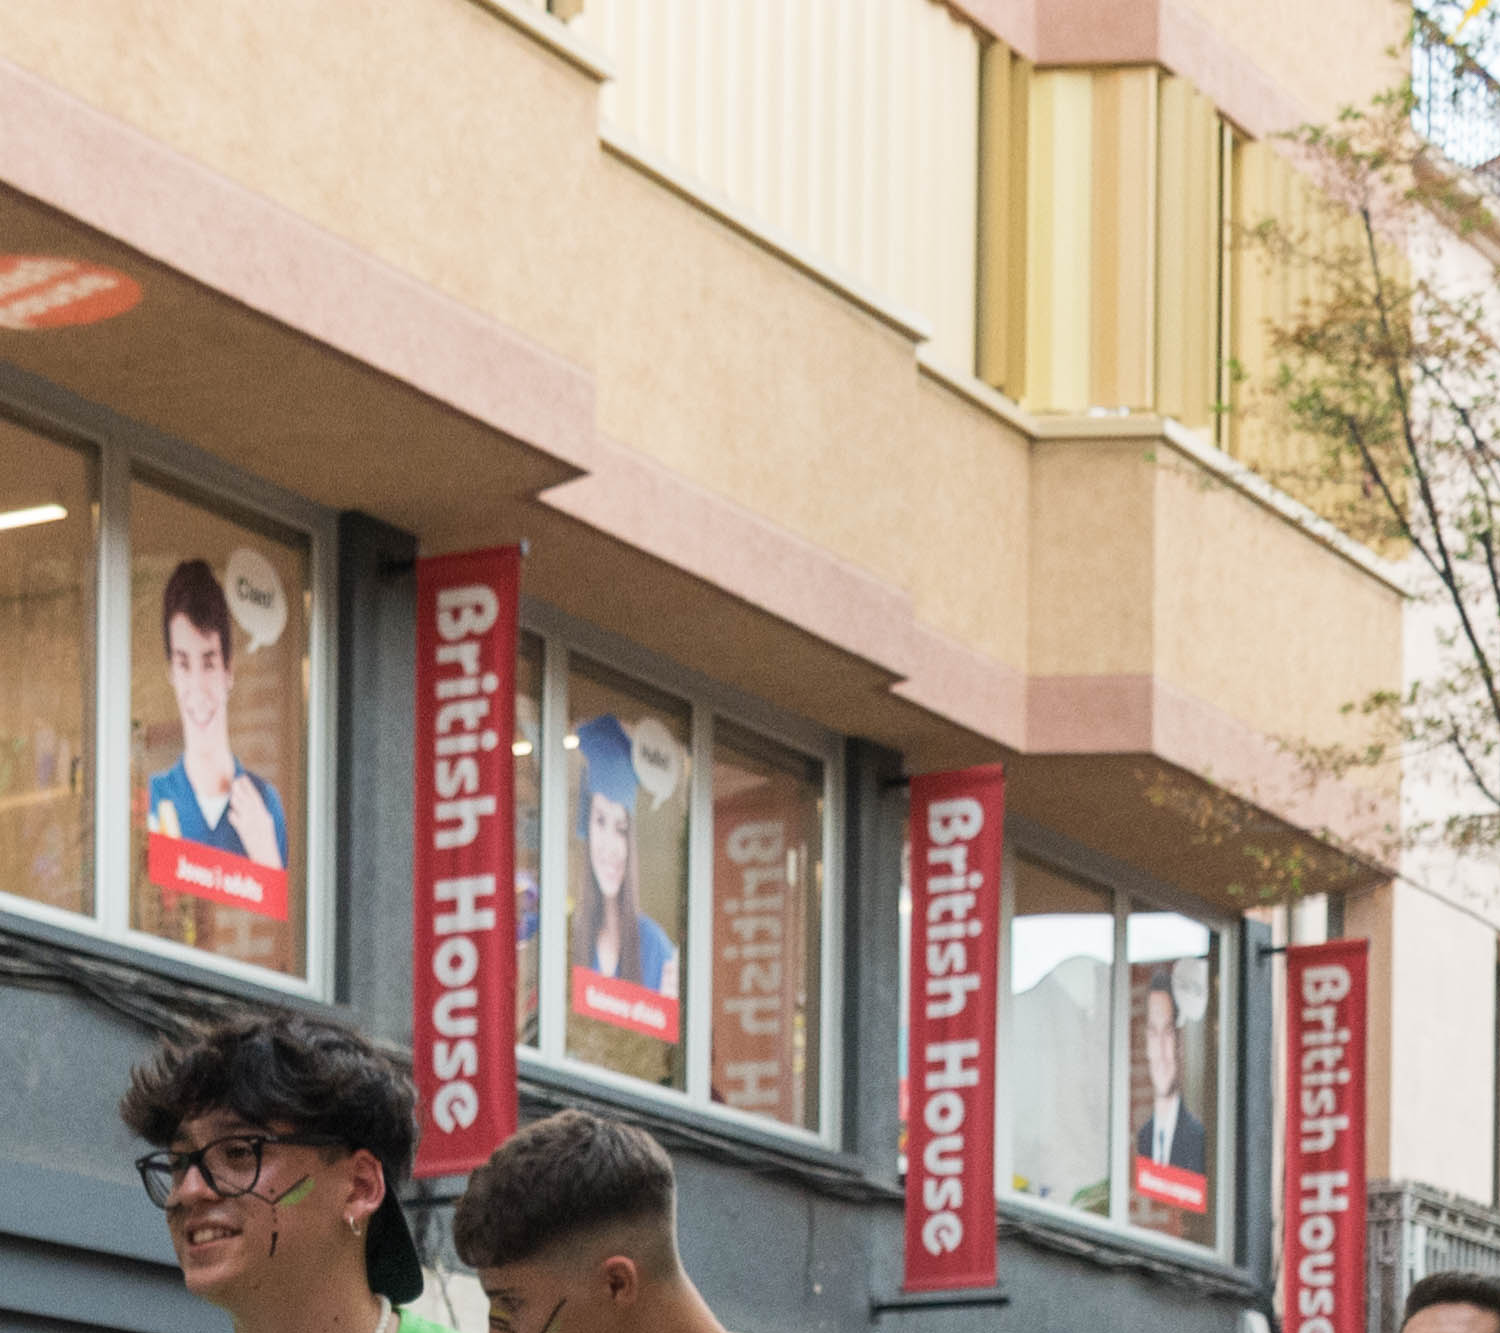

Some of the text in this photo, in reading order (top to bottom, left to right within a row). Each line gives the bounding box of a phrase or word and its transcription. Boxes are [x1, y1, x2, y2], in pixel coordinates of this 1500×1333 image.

[432, 583, 499, 1136] British House
[922, 797, 984, 1257] British House
[1301, 964, 1352, 1155] British
